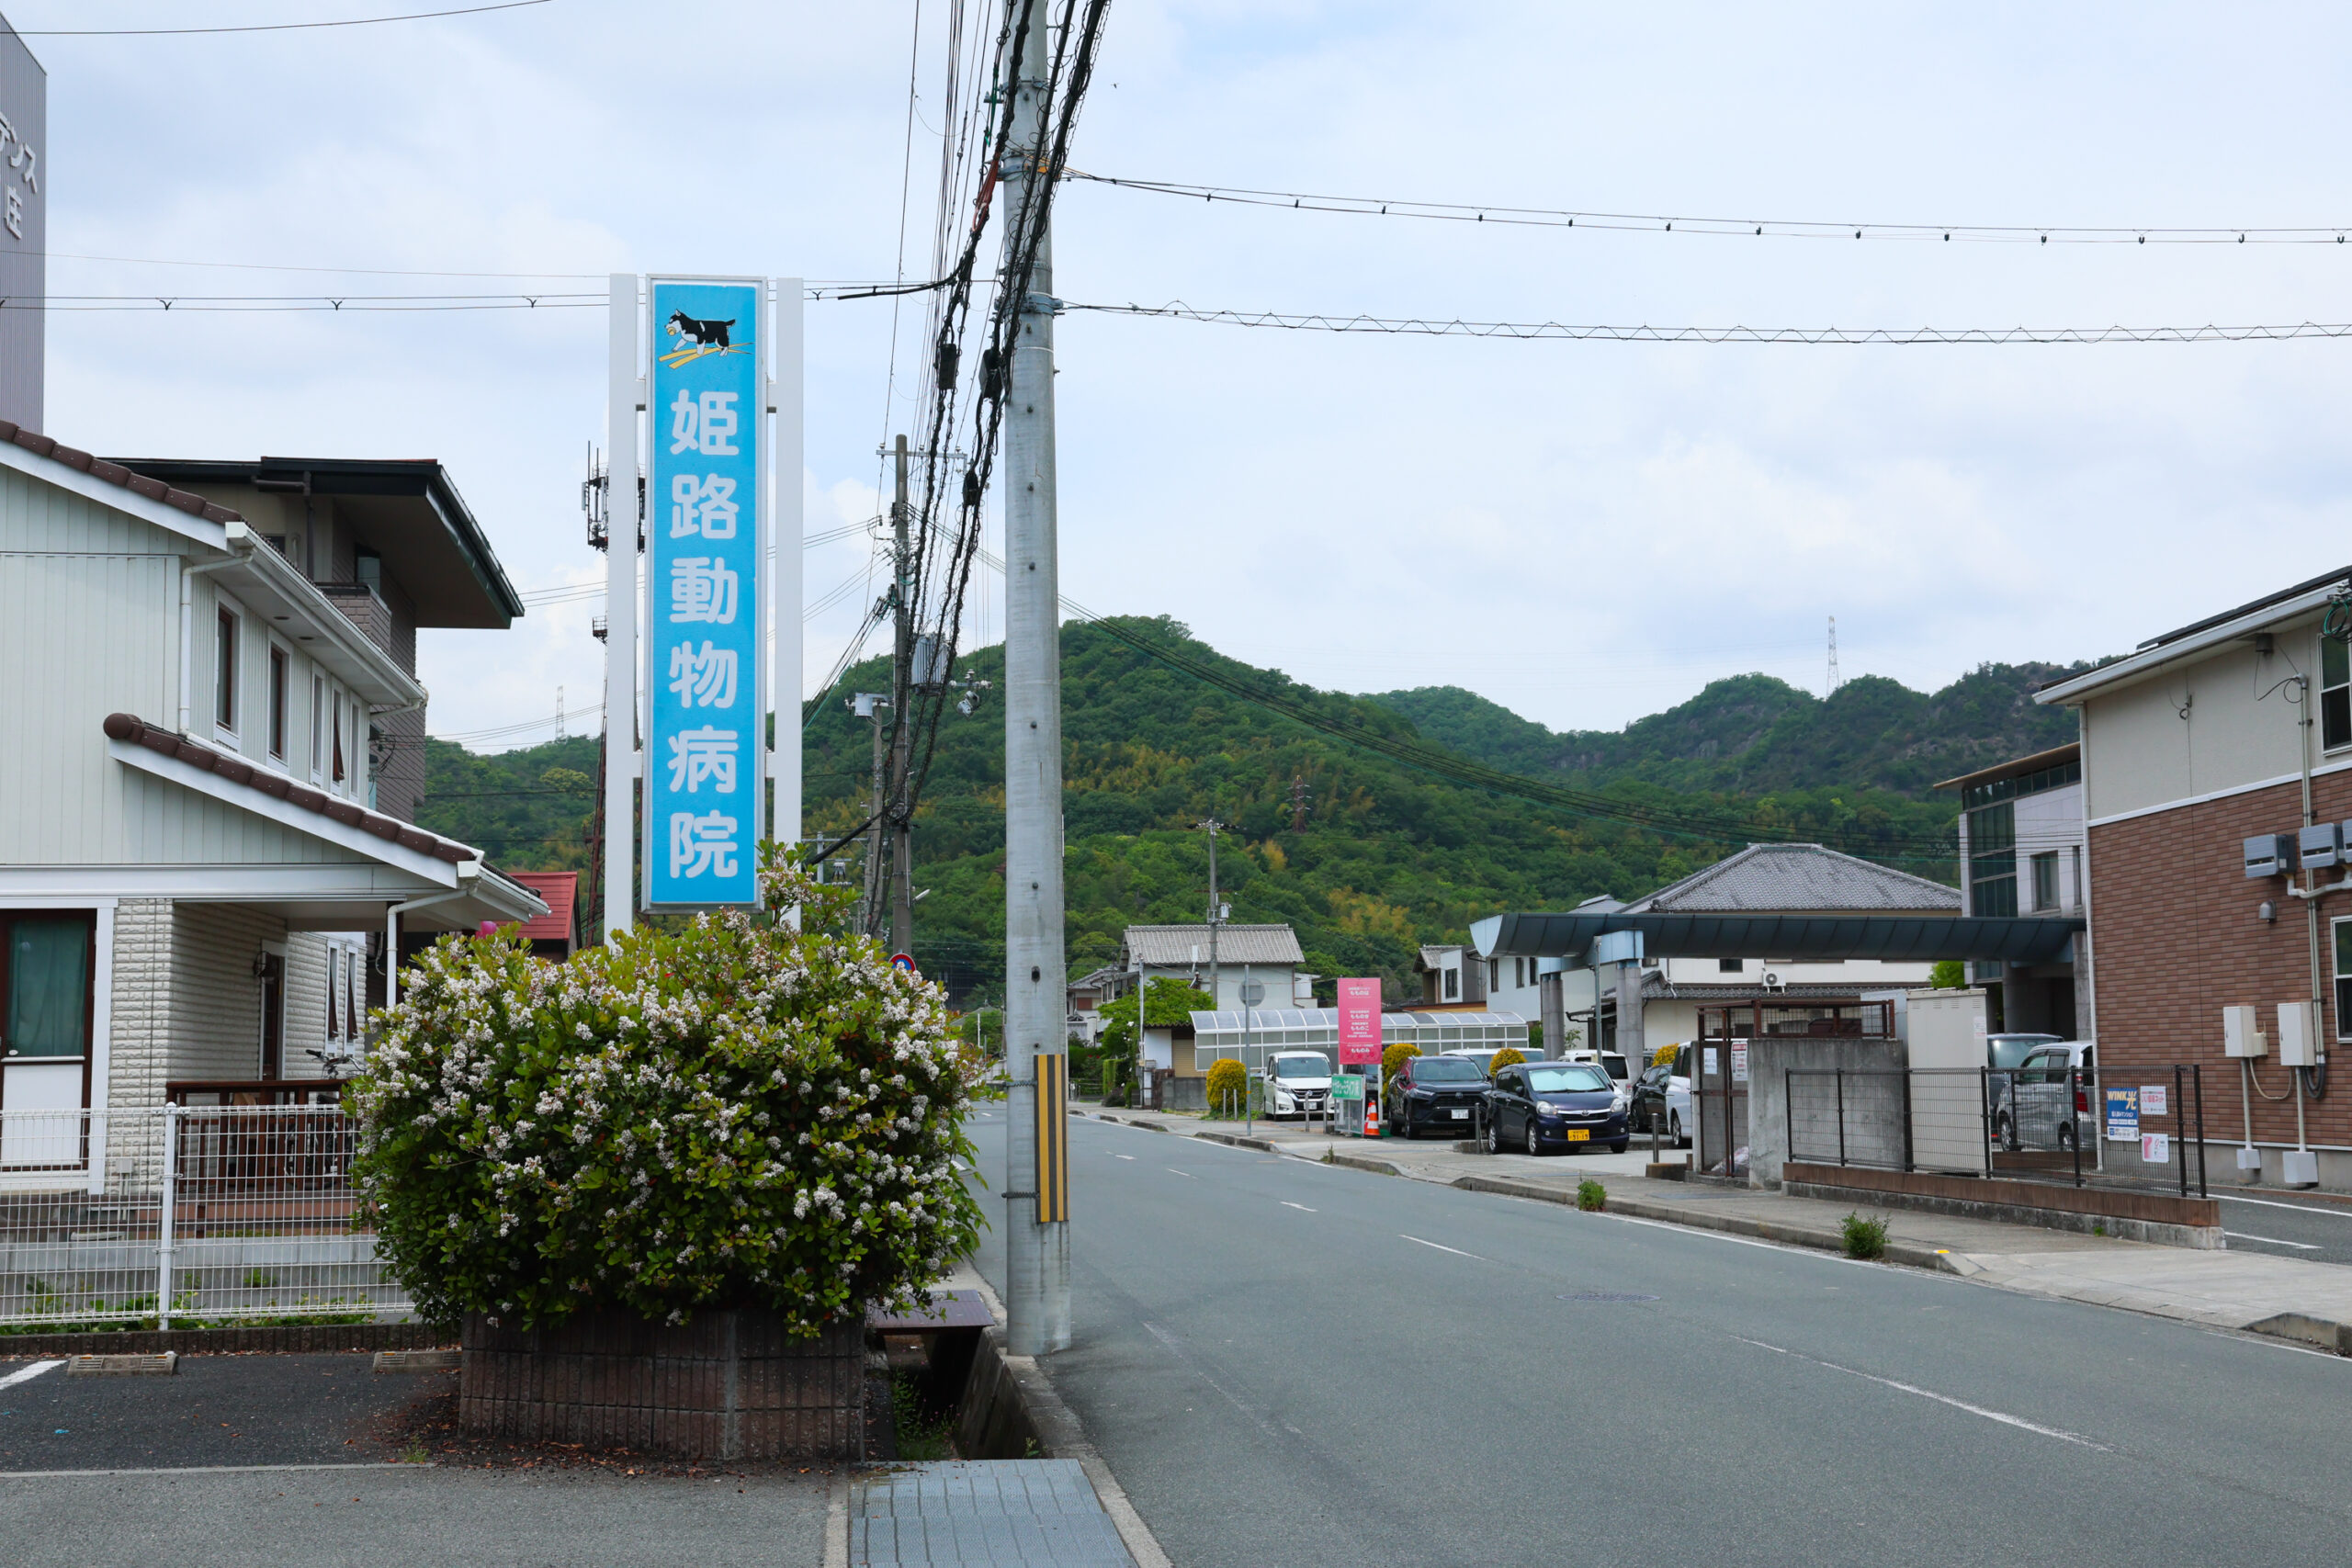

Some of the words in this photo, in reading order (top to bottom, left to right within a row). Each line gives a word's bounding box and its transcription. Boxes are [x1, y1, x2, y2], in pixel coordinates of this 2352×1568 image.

[667, 389, 740, 880] 姫路動物病院
